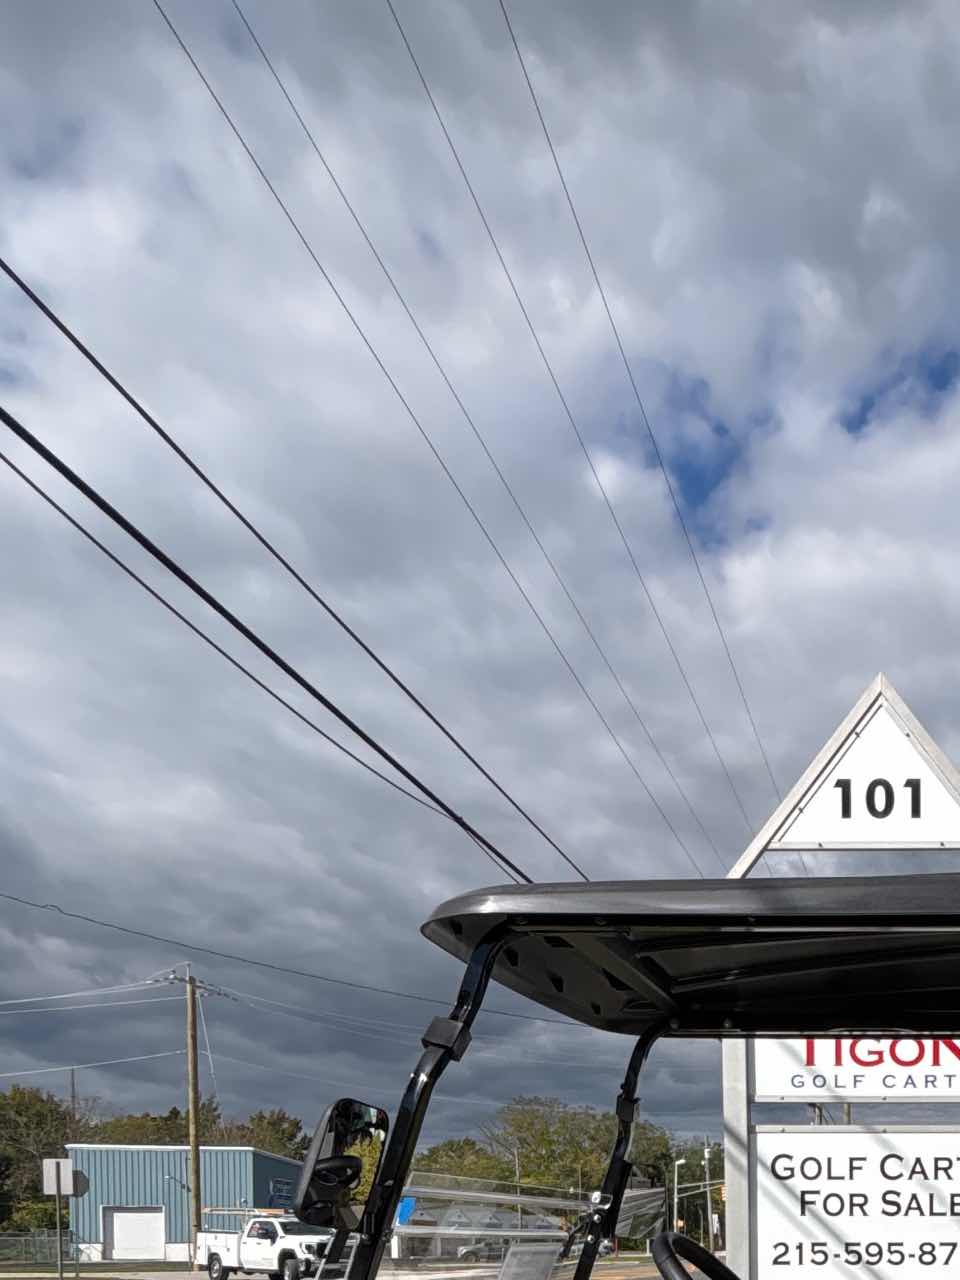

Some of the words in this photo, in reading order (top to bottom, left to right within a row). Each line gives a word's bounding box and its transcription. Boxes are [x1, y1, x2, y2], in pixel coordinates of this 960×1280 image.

[833, 777, 921, 819] 101
[791, 1074, 865, 1089] GOLF
[770, 1153, 867, 1181] GOLF
[800, 1190, 869, 1217] FOR
